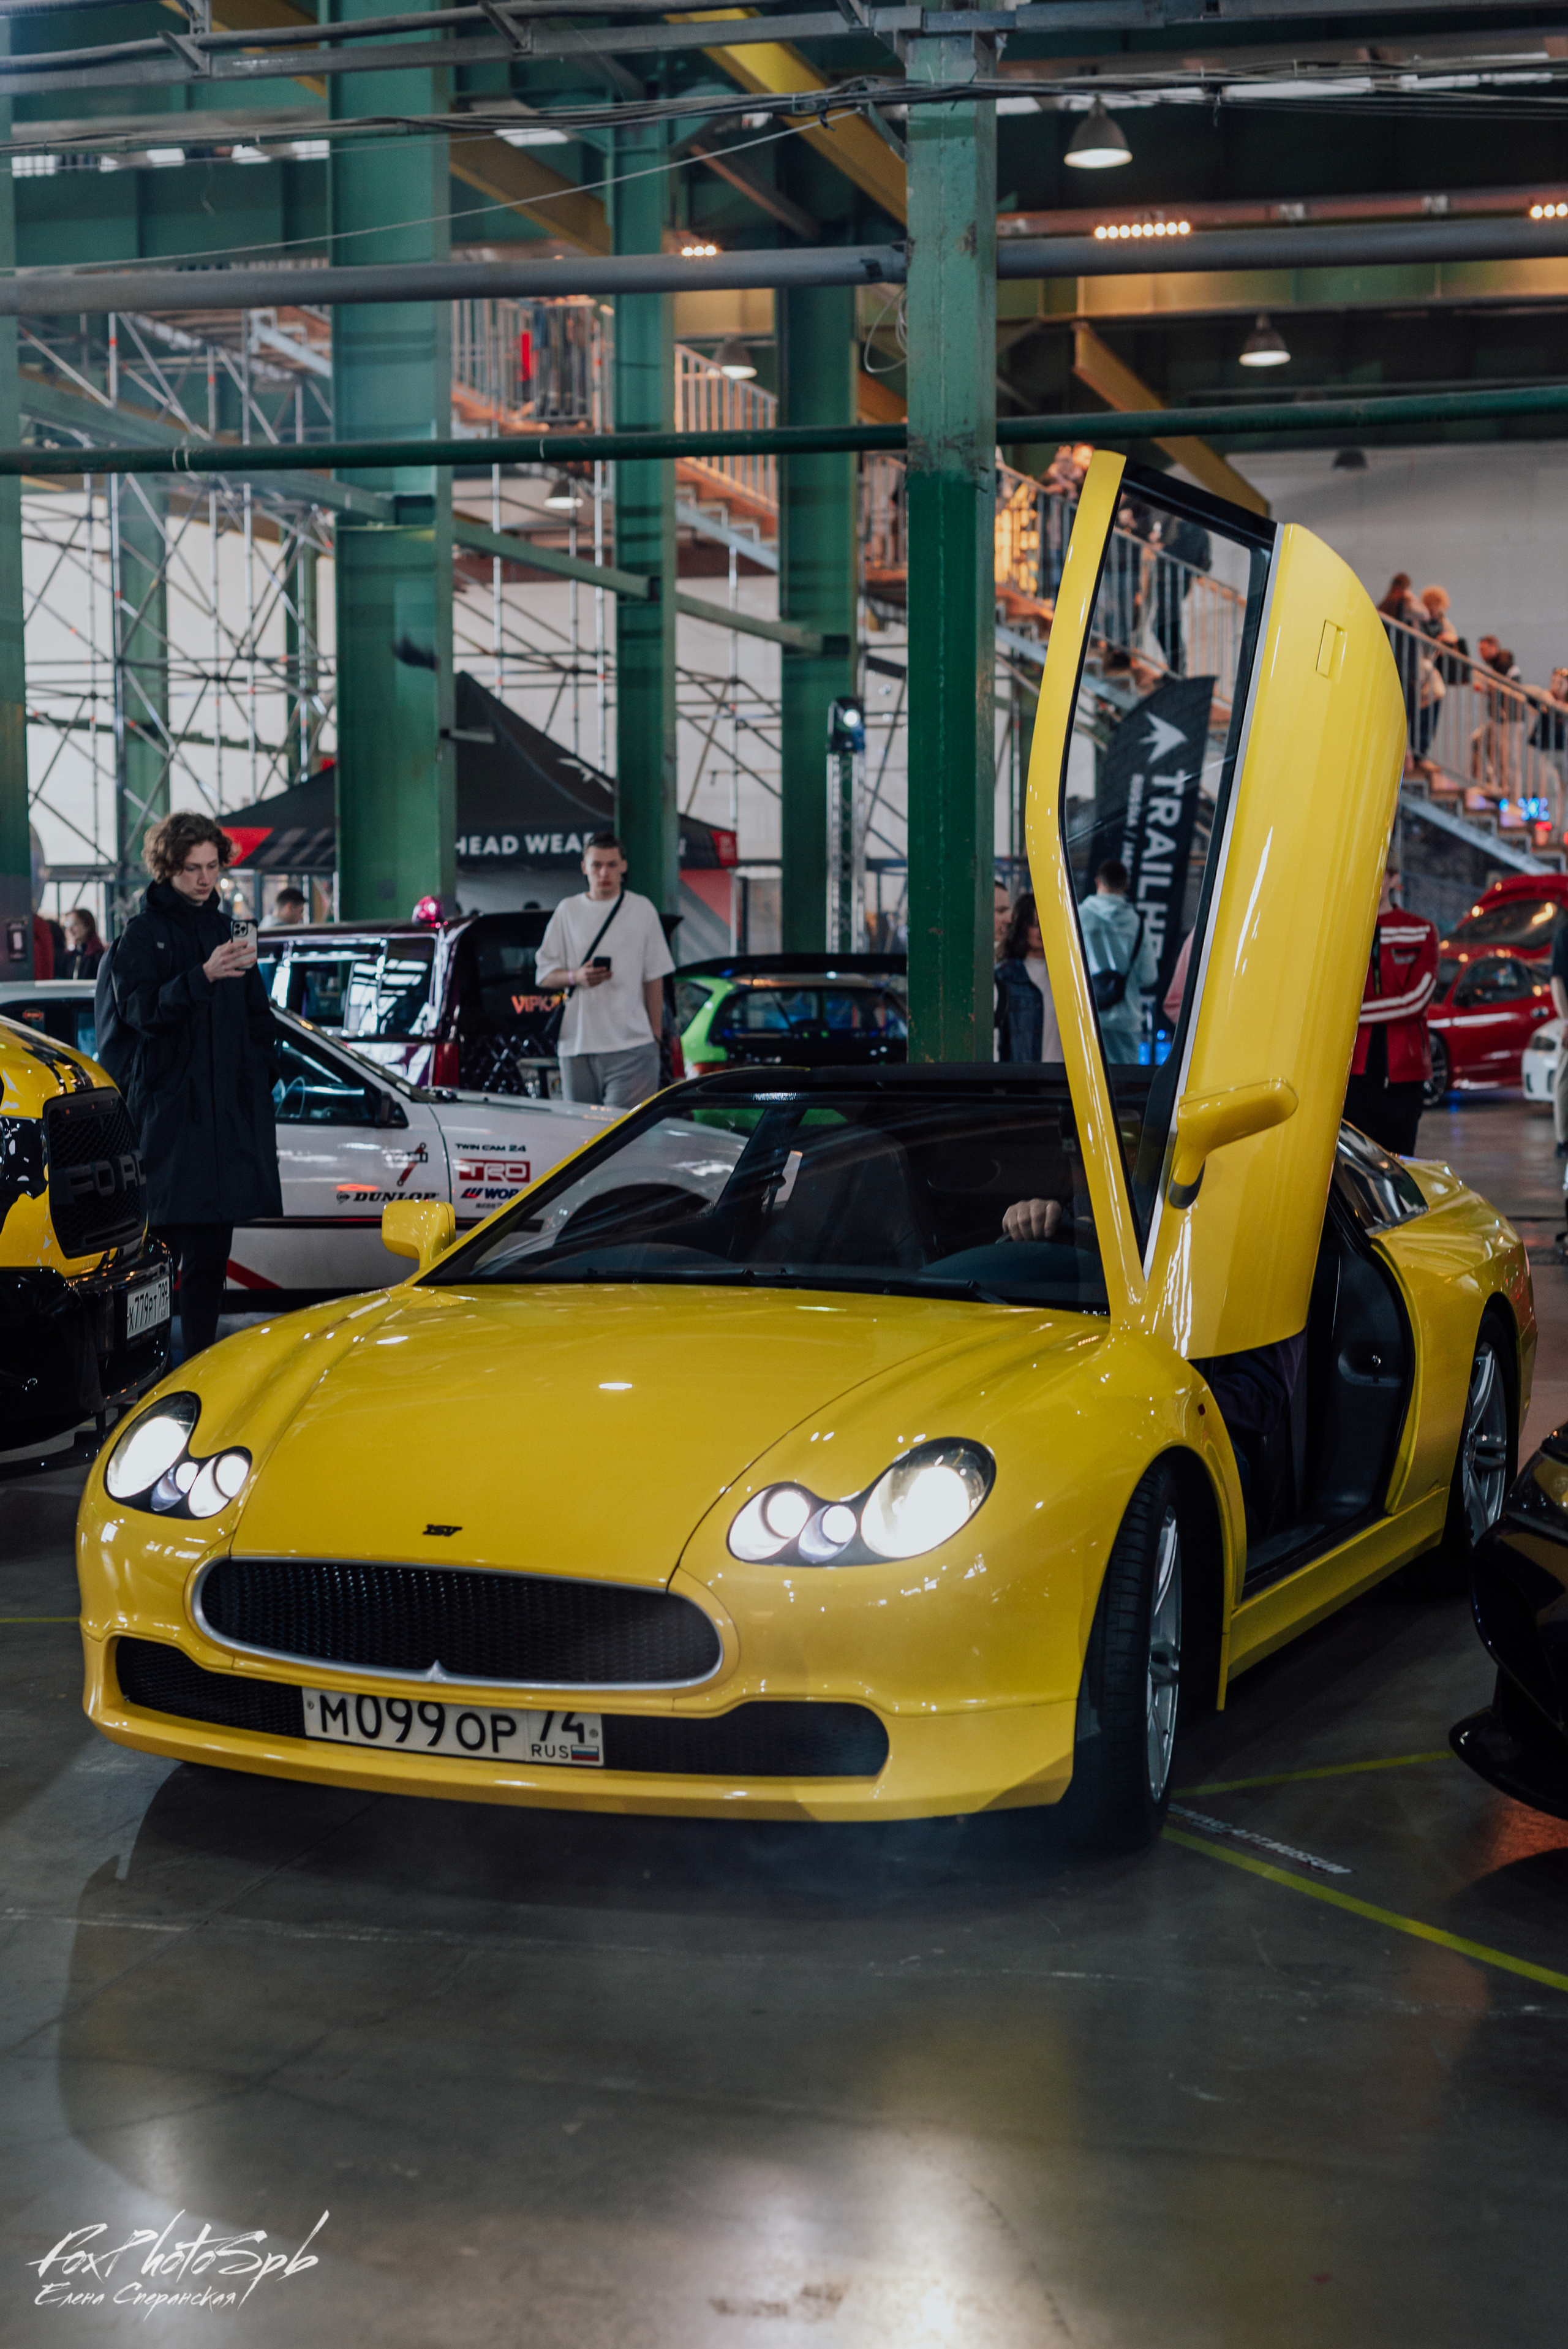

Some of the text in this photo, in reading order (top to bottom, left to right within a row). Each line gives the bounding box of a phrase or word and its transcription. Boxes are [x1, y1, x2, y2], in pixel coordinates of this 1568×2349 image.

[455, 834, 519, 856] HEAD
[461, 1161, 528, 1182] TRD
[353, 1191, 437, 1201] DUNLOP
[484, 1187, 522, 1200] WOR
[531, 1743, 568, 1759] RUS
